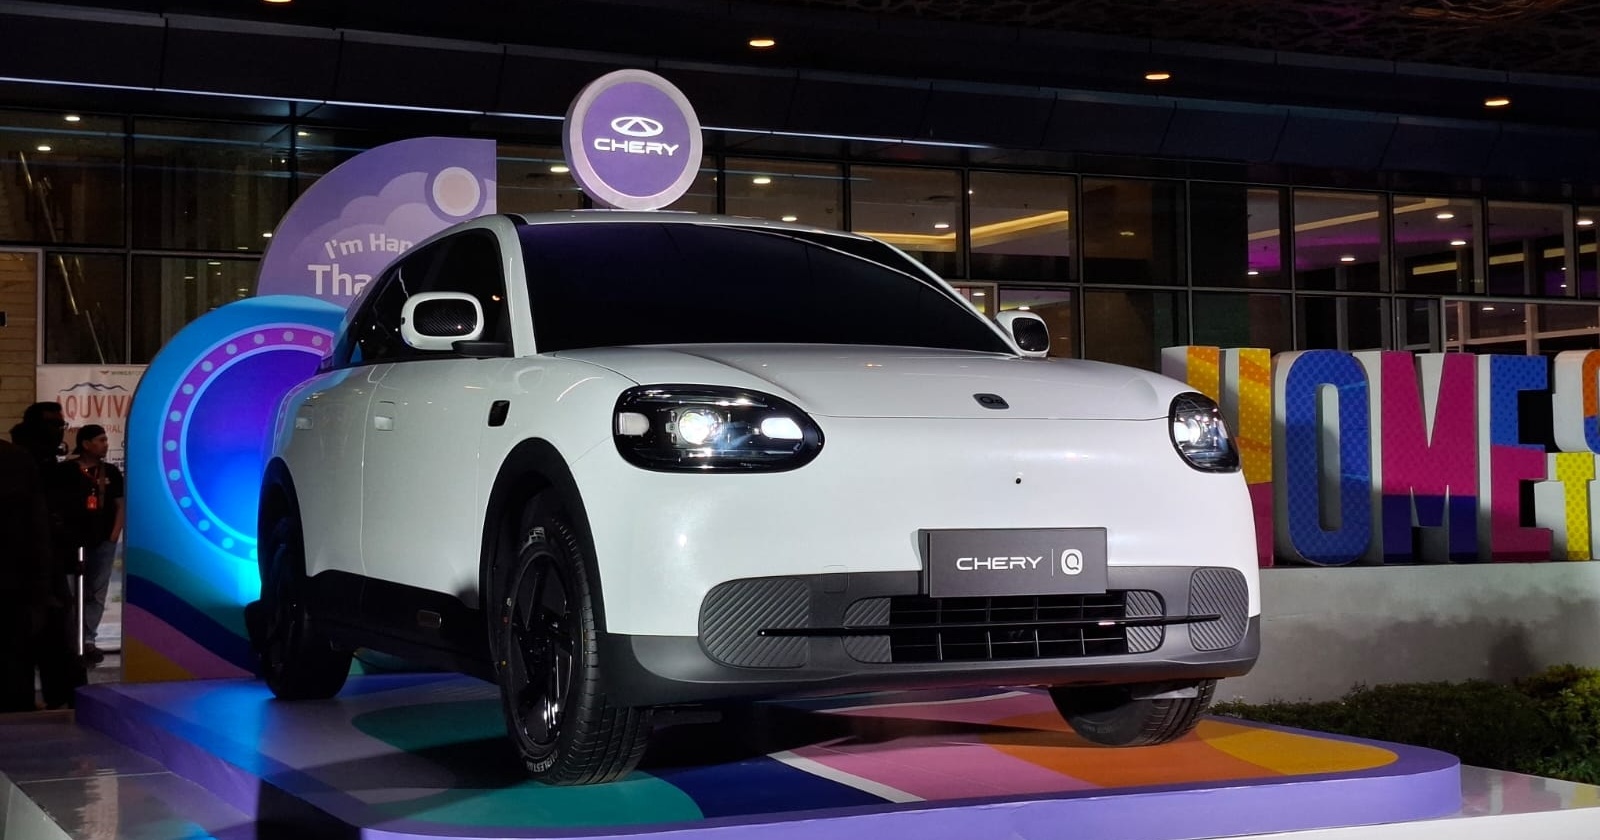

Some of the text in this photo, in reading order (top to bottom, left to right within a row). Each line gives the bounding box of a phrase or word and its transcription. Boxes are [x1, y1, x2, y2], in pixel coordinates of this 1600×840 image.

[594, 138, 679, 156] CHERY
[324, 233, 414, 260] I'm Hap
[307, 263, 373, 296] Tha
[956, 556, 1044, 571] CHERY
